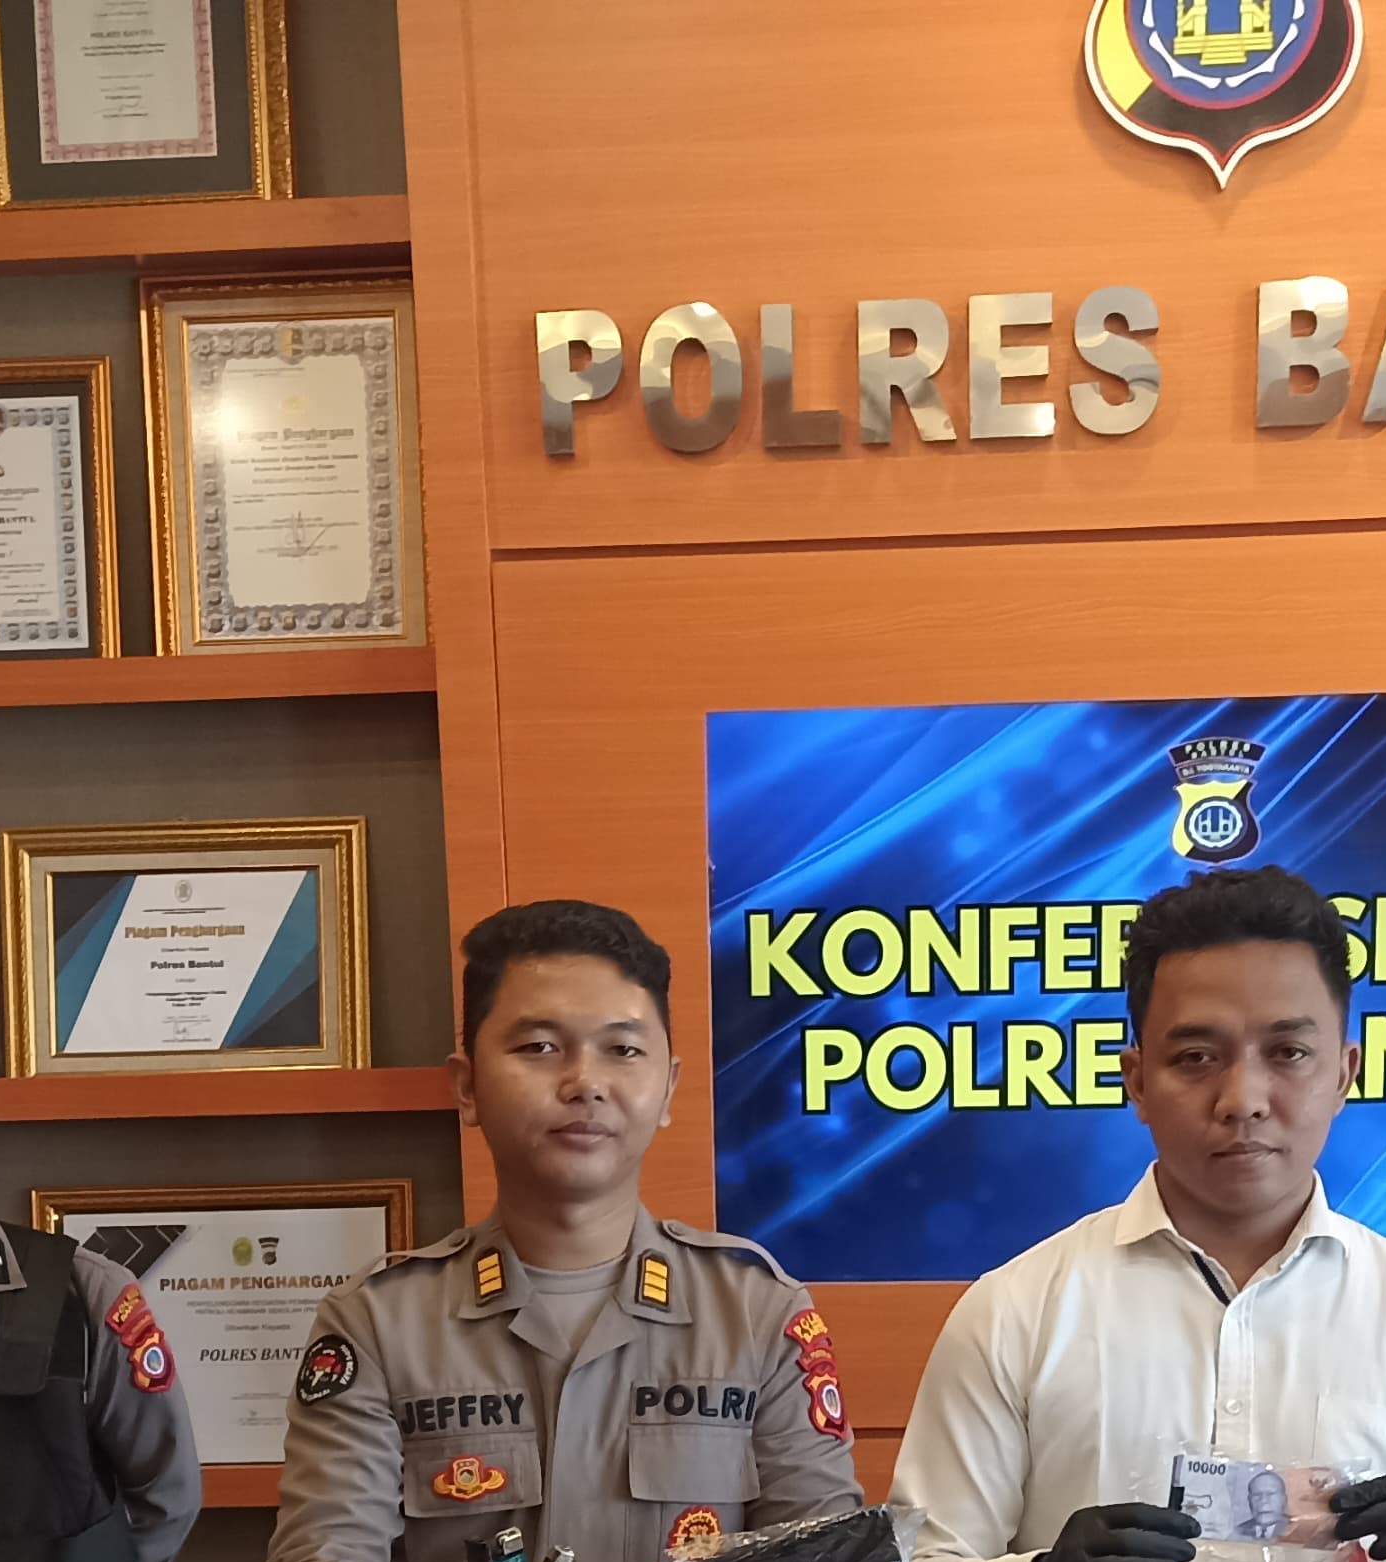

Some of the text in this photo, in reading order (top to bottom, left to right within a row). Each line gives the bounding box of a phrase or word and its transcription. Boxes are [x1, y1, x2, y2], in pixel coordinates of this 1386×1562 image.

[536, 285, 1160, 456] POLRES
[805, 1021, 1124, 1111] POLRE
[159, 1277, 225, 1292] PIAGAM
[199, 1346, 303, 1362] POLRES BANT
[400, 1393, 525, 1434] JEFFRY
[635, 1384, 757, 1422] POLRI
[1187, 1460, 1227, 1476] 10000
